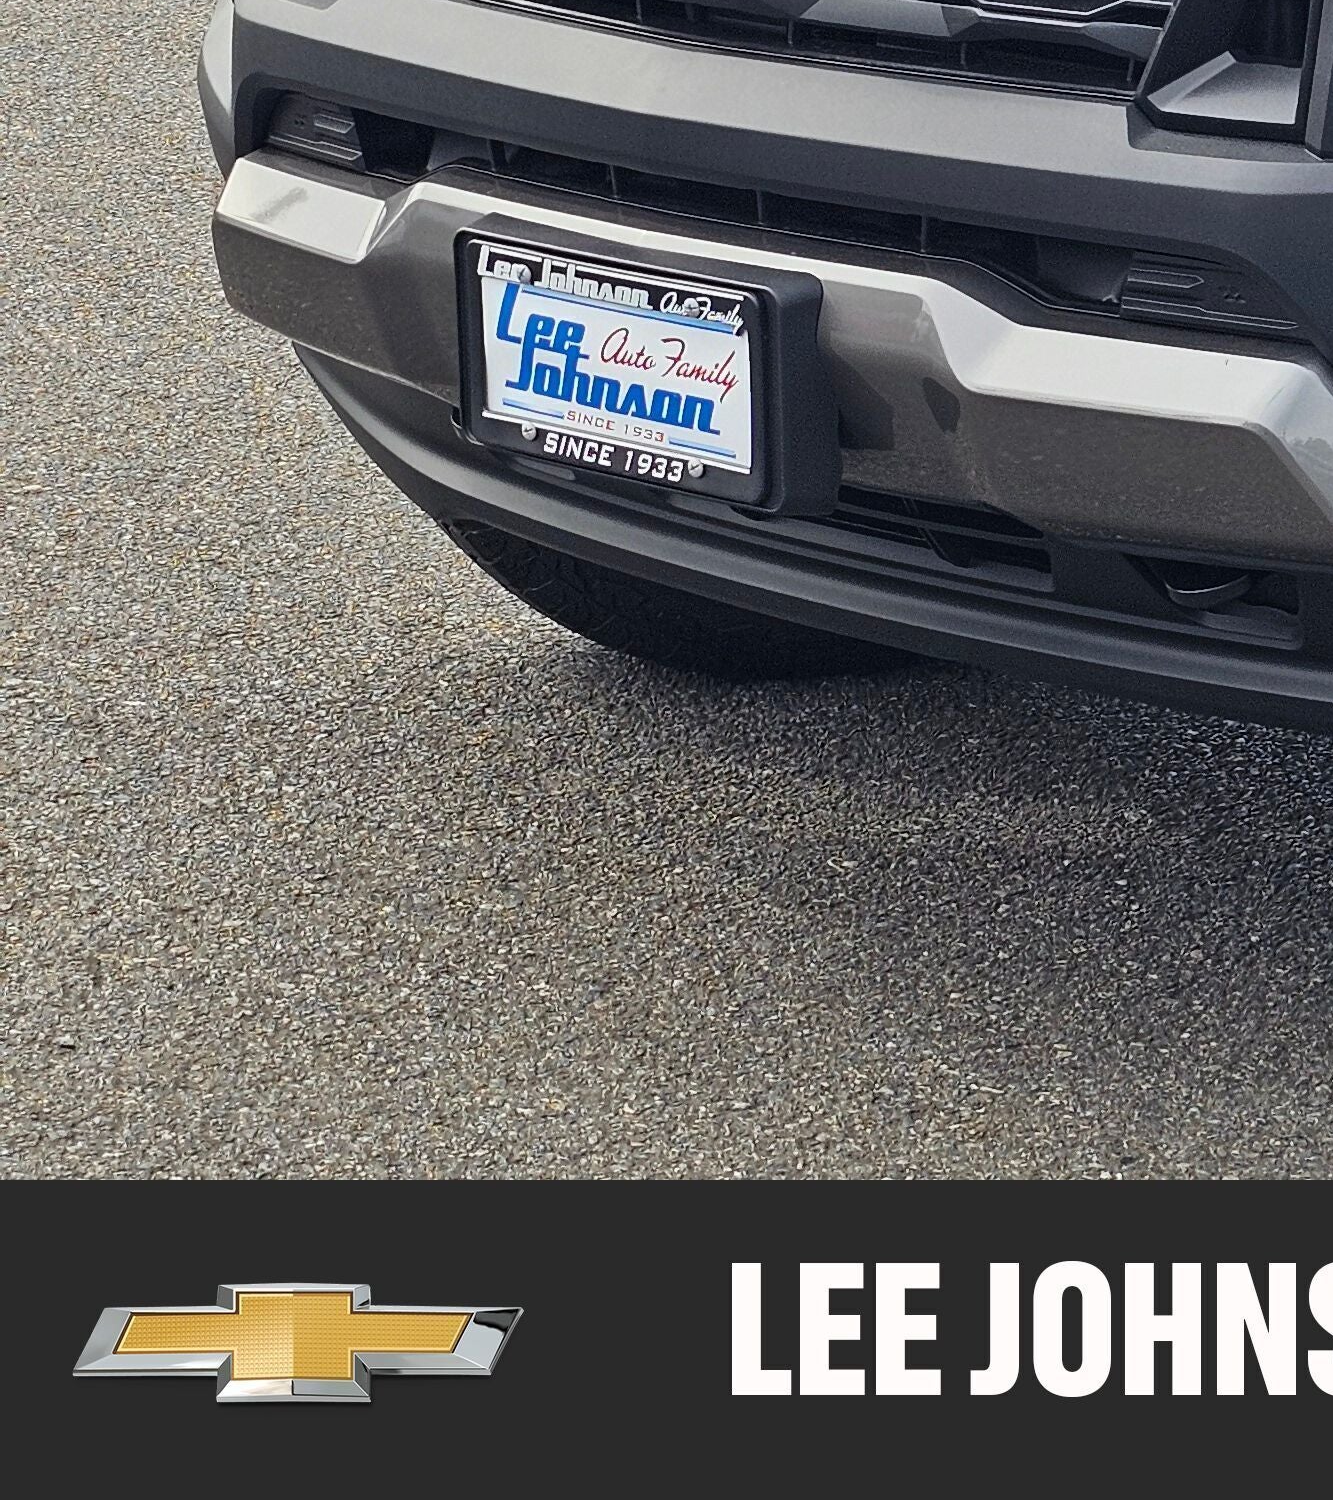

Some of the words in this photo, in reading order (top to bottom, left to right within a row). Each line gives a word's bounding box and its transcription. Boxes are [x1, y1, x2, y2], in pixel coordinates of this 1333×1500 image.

[534, 258, 653, 310] Johnson
[496, 284, 588, 359] Lee
[505, 348, 721, 436] Johnson
[600, 328, 657, 370] Auto
[661, 338, 739, 402] Family
[543, 432, 615, 467] SINCE
[623, 453, 684, 483] 1933
[566, 410, 616, 431] SINCE
[624, 422, 665, 443] 1933
